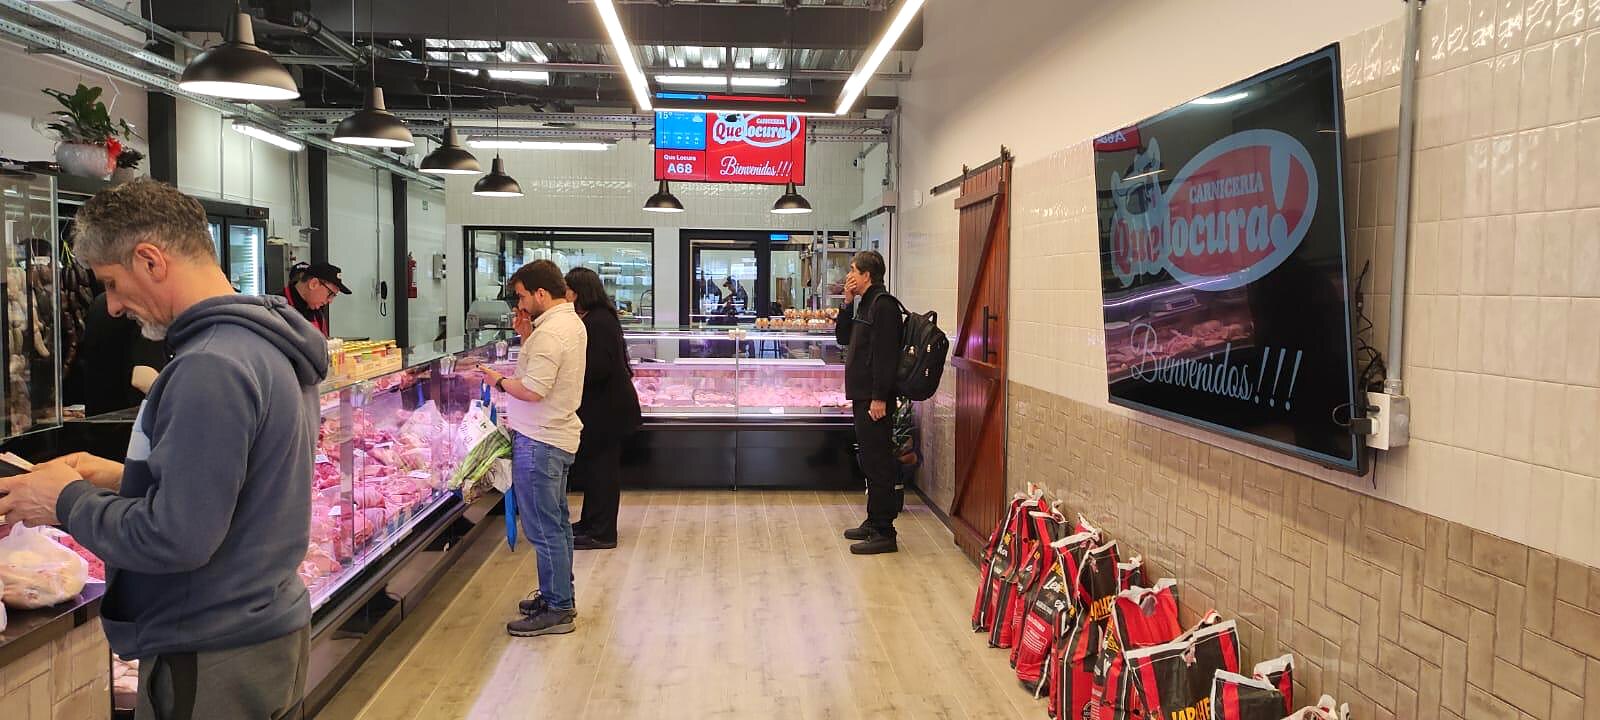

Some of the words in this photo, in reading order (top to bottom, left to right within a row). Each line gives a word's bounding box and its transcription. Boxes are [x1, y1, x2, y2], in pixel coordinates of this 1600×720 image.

[715, 121, 743, 140] Que
[667, 163, 694, 174] A68
[719, 155, 793, 177] Bienvenidos!!!
[1189, 172, 1264, 204] CARNICERIA
[1113, 219, 1162, 276] Que
[1130, 322, 1303, 412] Bienvenidos!!!
